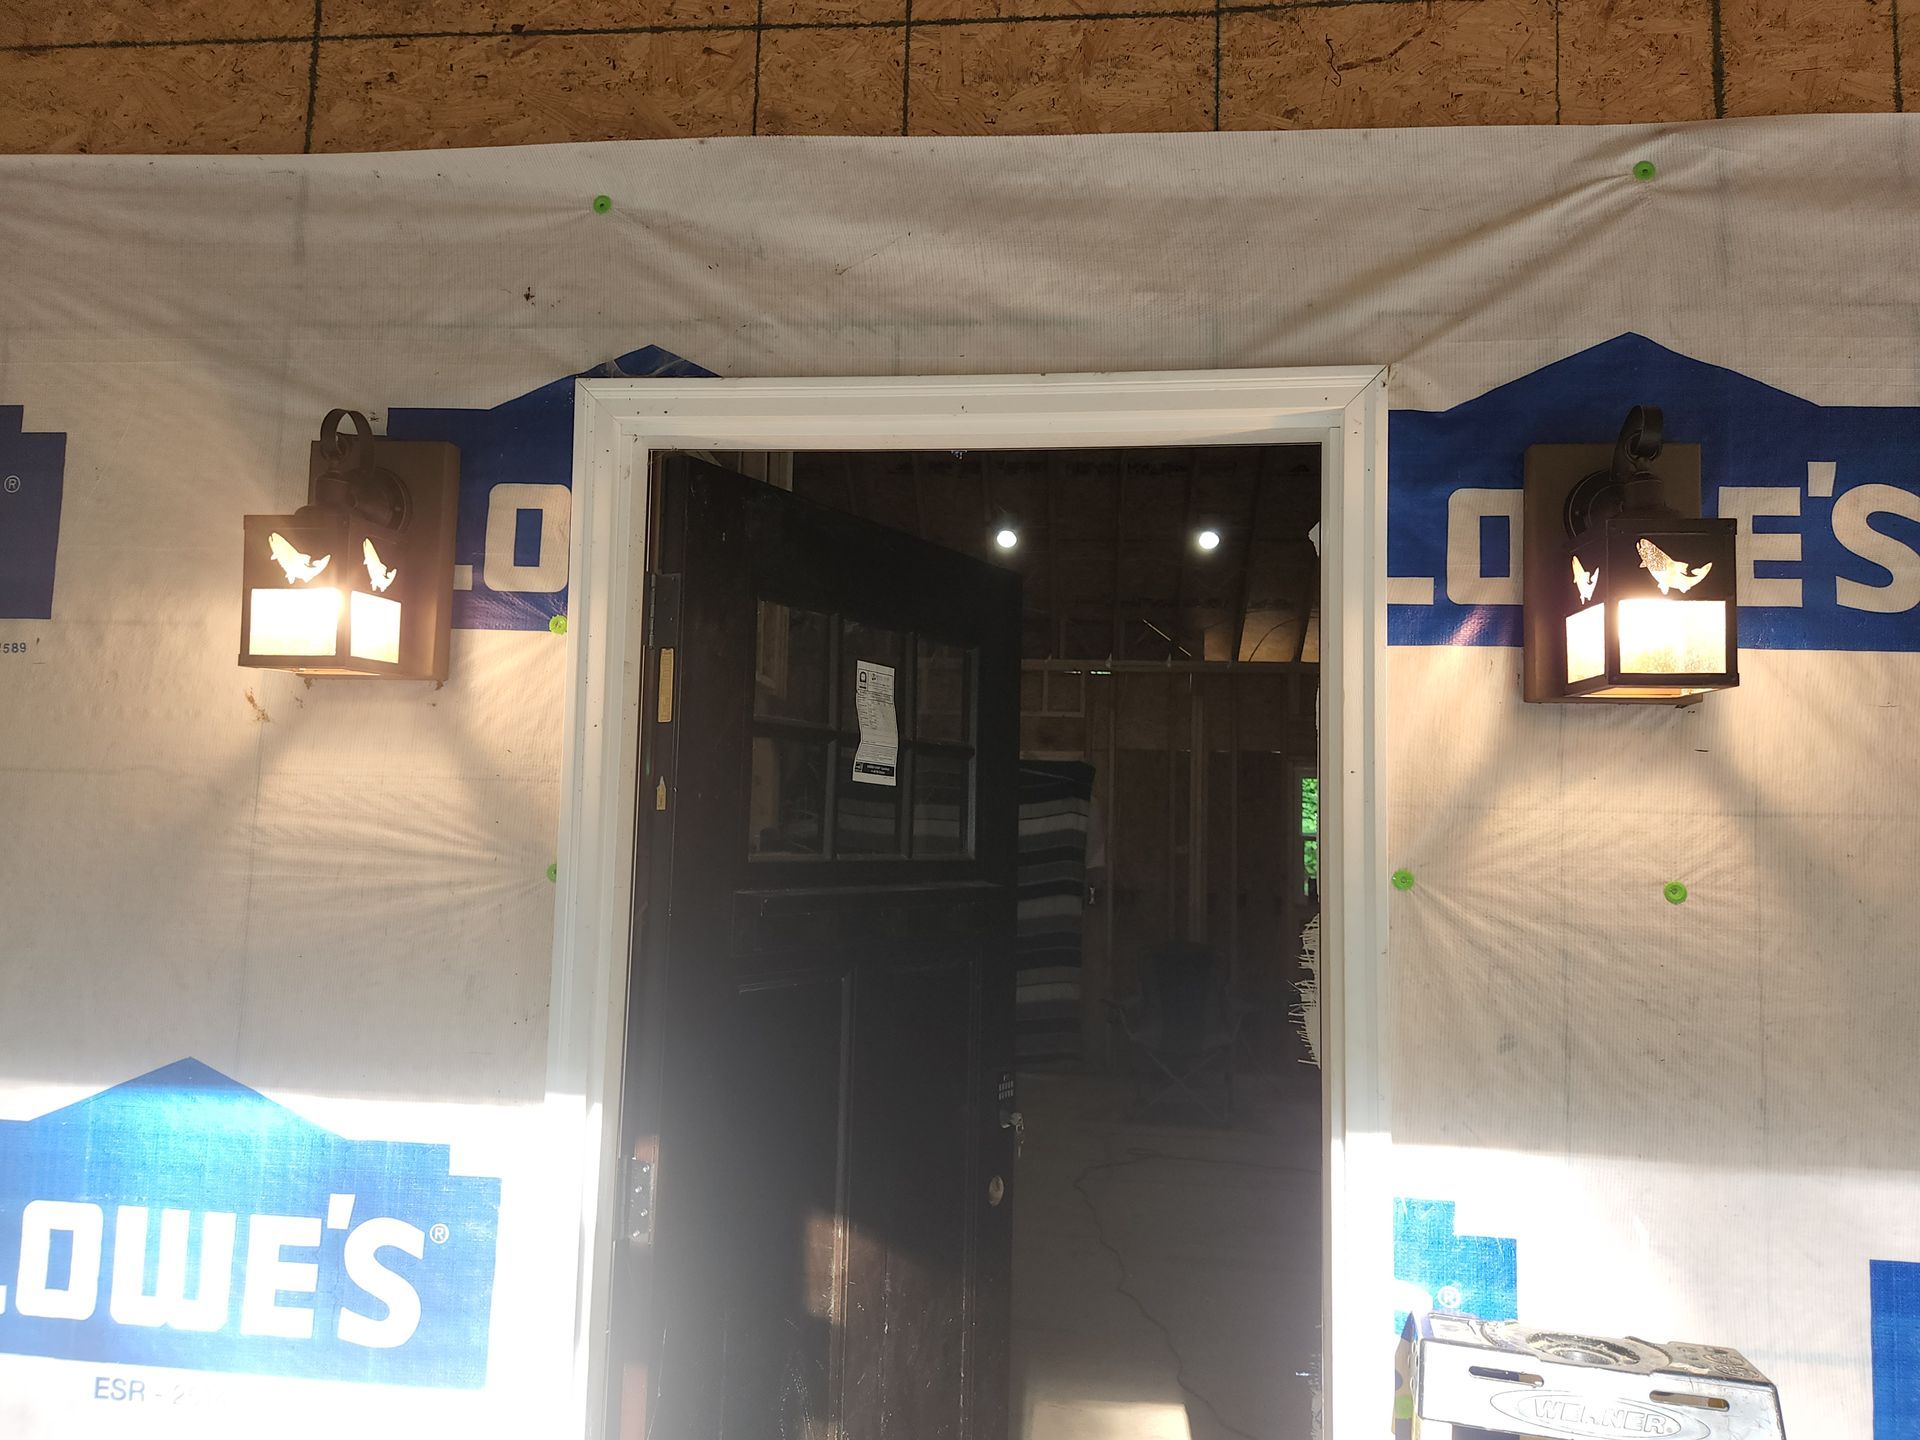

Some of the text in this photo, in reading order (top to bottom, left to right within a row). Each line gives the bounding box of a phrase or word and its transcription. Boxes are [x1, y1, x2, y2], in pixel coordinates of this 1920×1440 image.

[1388, 461, 1920, 613] OE'S
[0, 642, 26, 654] 589
[0, 1193, 425, 1348] OWE'S
[94, 1377, 146, 1402] ESR
